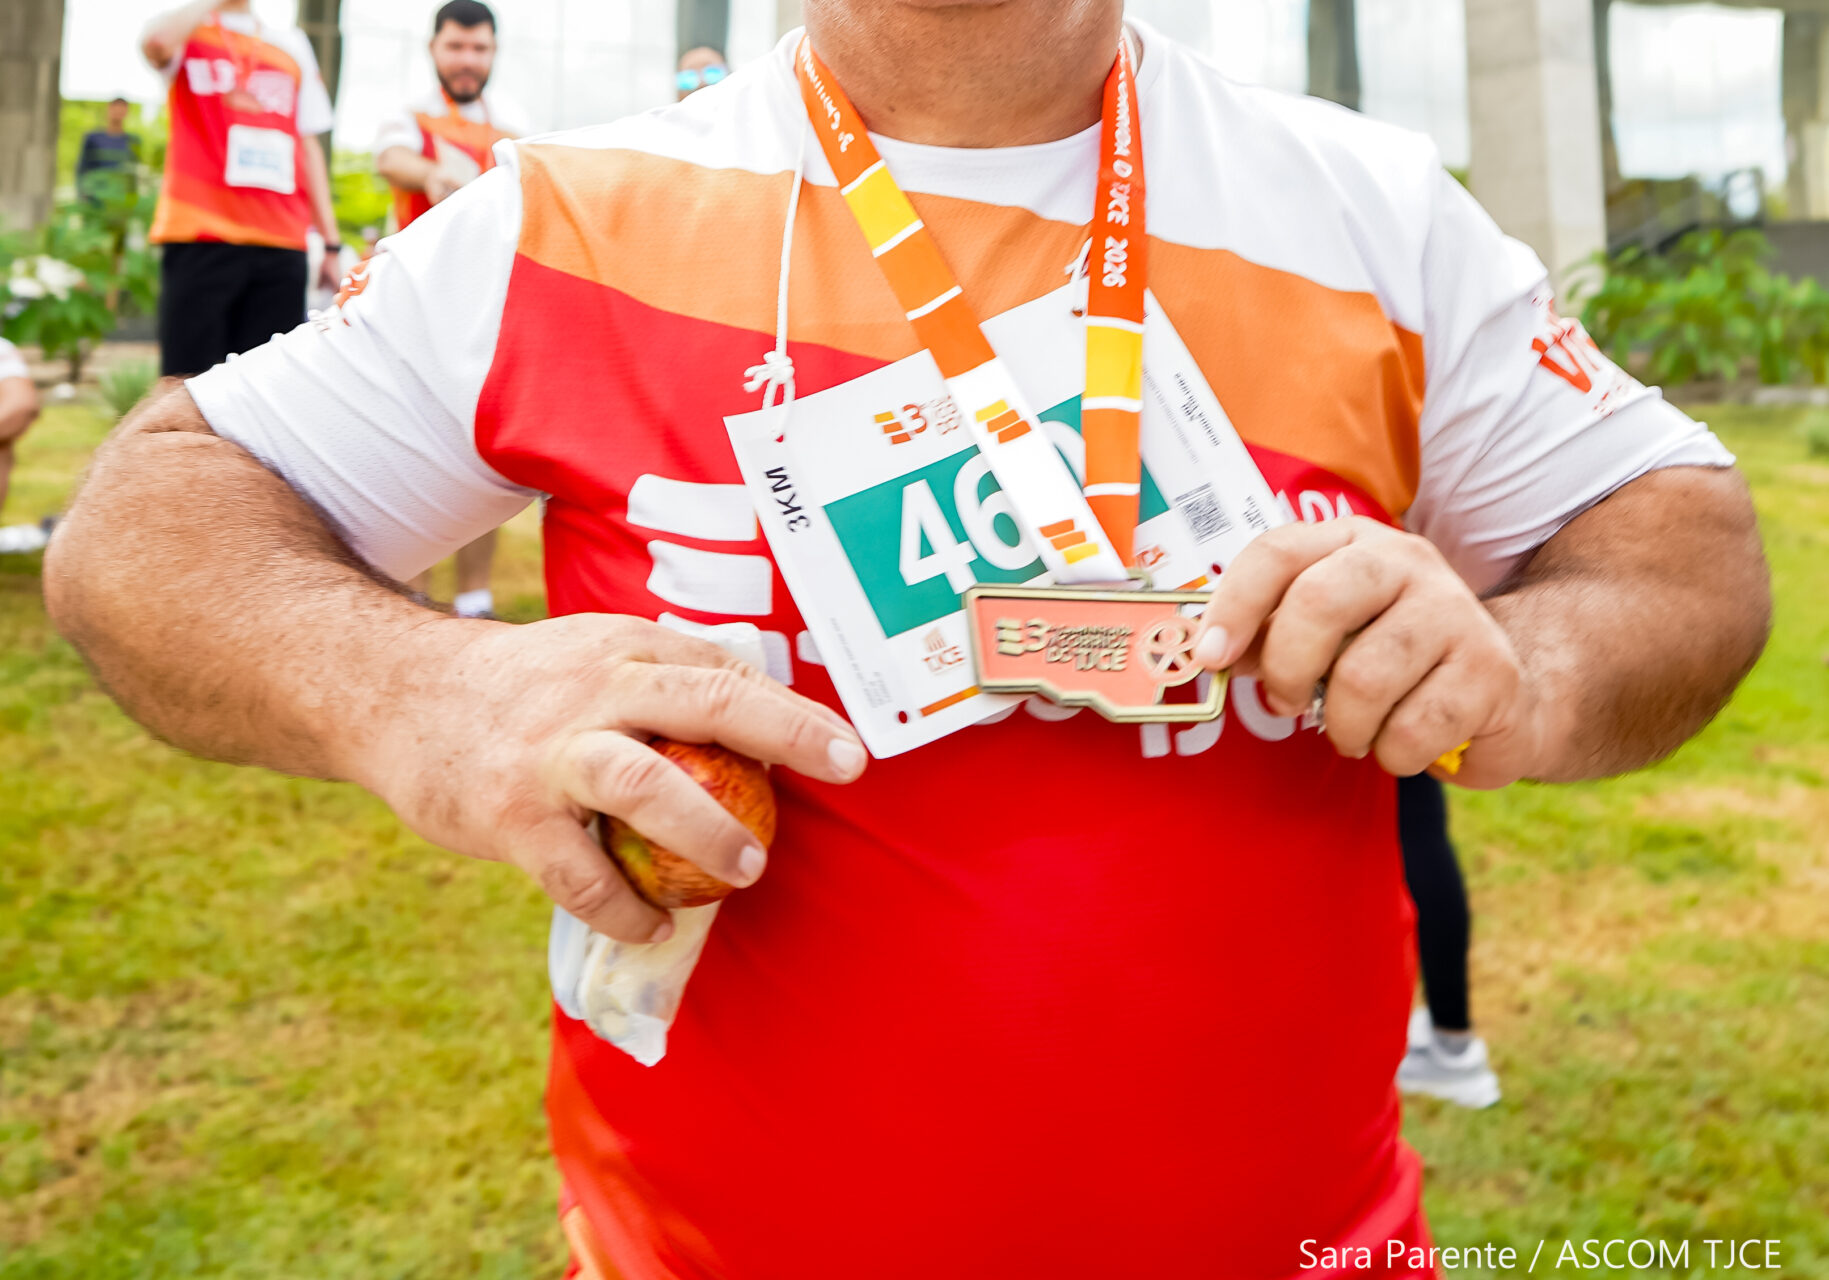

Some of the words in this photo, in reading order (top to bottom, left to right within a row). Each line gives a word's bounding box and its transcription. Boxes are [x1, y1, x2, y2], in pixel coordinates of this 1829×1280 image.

[1101, 235, 1129, 289] 2026
[764, 465, 811, 534] 3KM
[1071, 647, 1128, 672] TJCE
